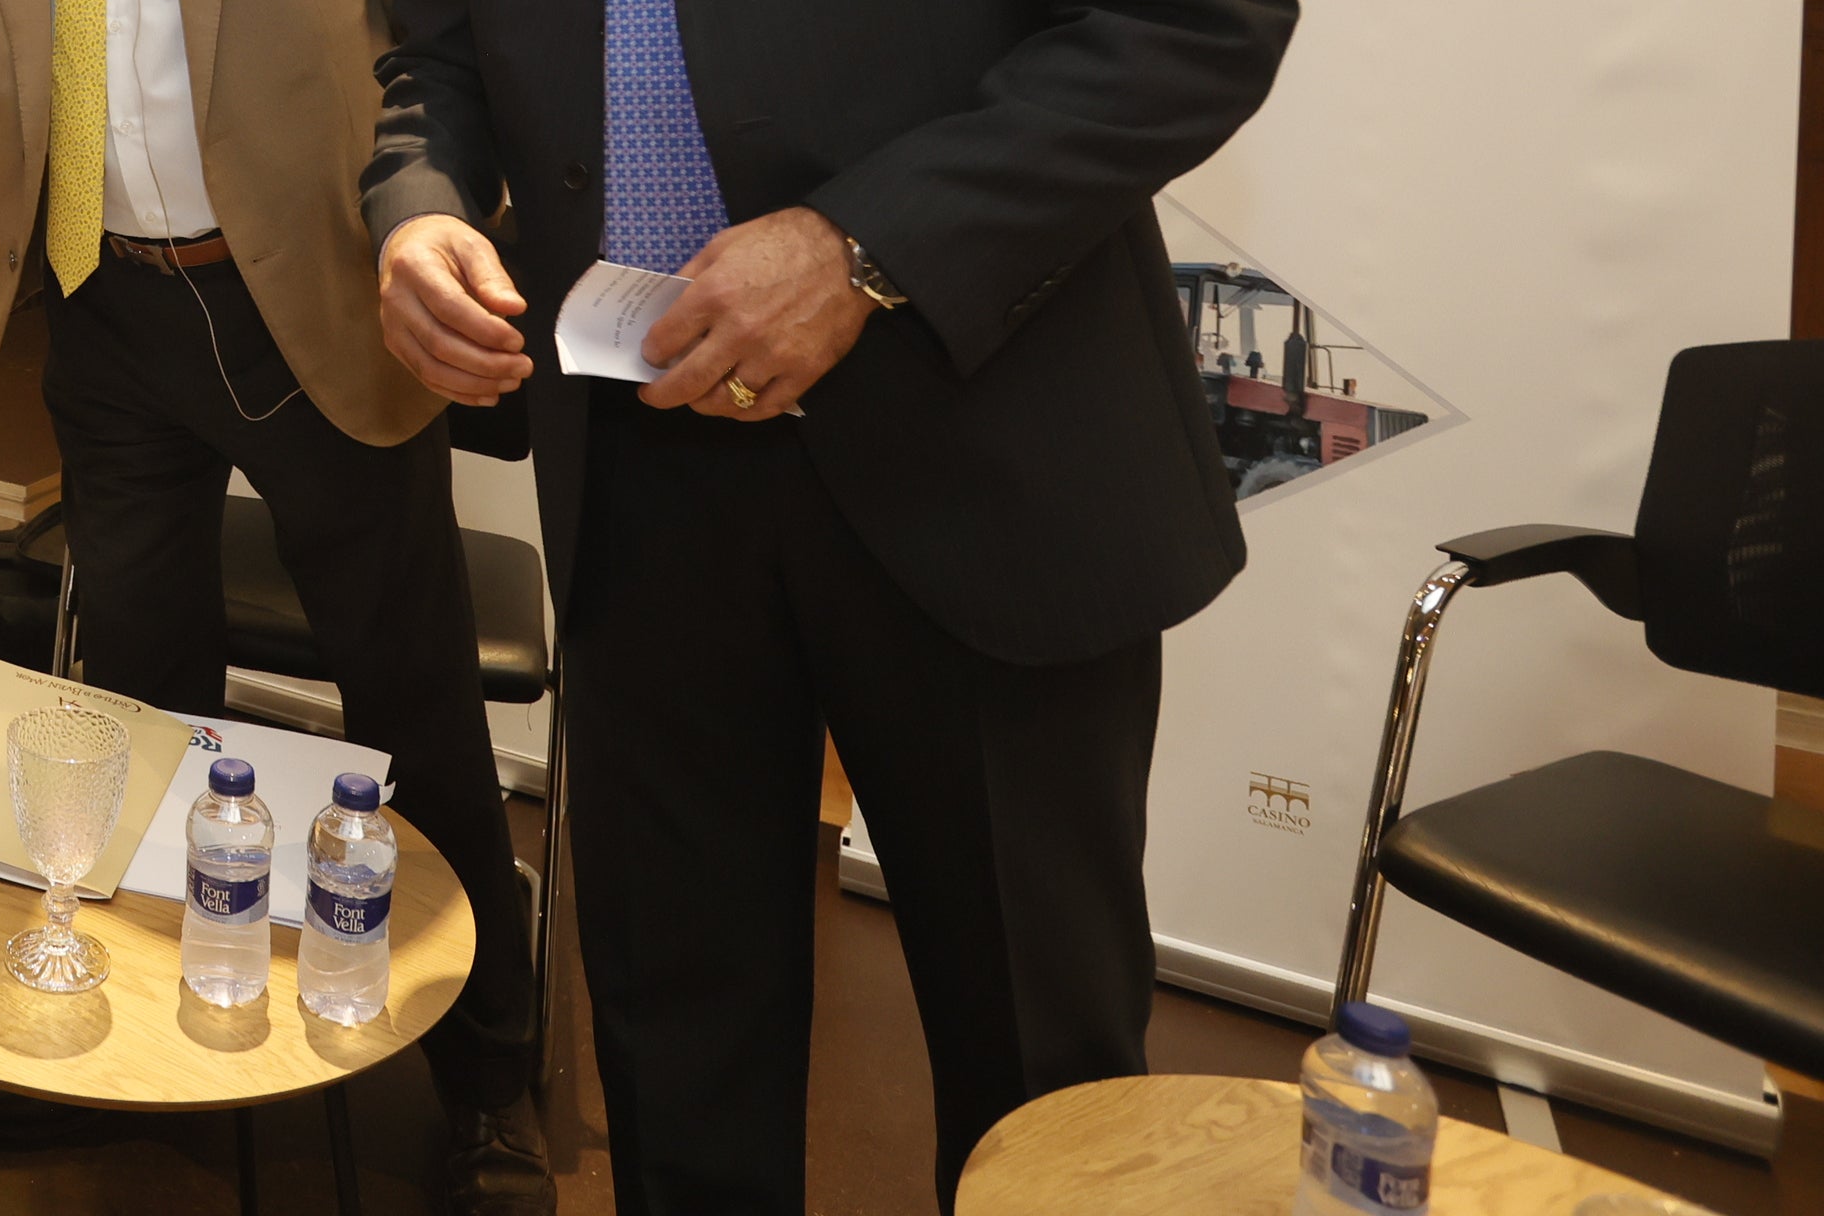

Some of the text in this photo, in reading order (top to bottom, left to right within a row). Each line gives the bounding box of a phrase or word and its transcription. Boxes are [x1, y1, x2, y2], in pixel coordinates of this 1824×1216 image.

[188, 735, 222, 753] Ro
[1247, 804, 1311, 828] CASINO
[201, 881, 231, 901] Font
[200, 893, 231, 914] Vella
[334, 902, 366, 920] Font
[332, 915, 366, 933] Vella
